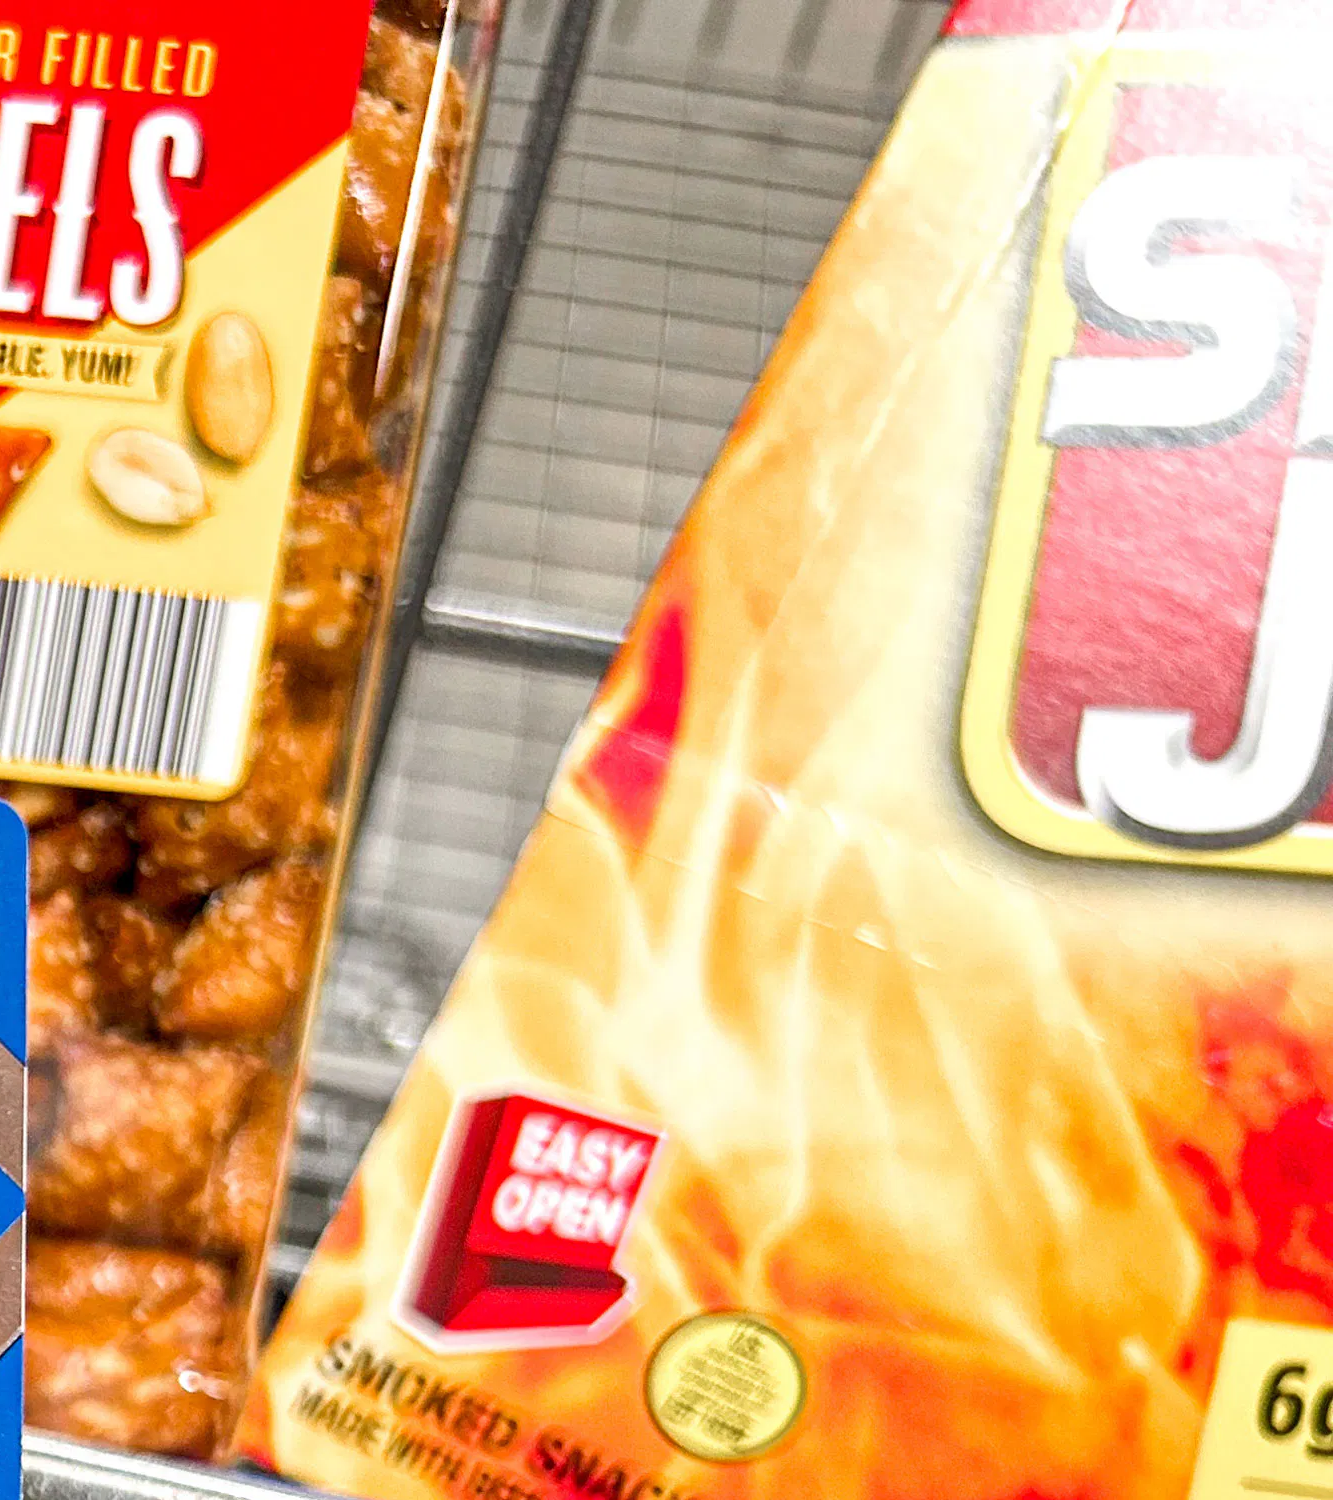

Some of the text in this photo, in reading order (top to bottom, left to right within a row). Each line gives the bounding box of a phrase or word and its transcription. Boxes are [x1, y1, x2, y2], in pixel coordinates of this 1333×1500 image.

[39, 29, 218, 98] FILLED
[61, 346, 137, 387] YUM!
[509, 1111, 649, 1193] EASY
[491, 1173, 626, 1247] OPEN
[316, 1335, 520, 1452] SMOKED
[294, 1383, 383, 1456] MADE
[384, 1423, 464, 1486] WITH
